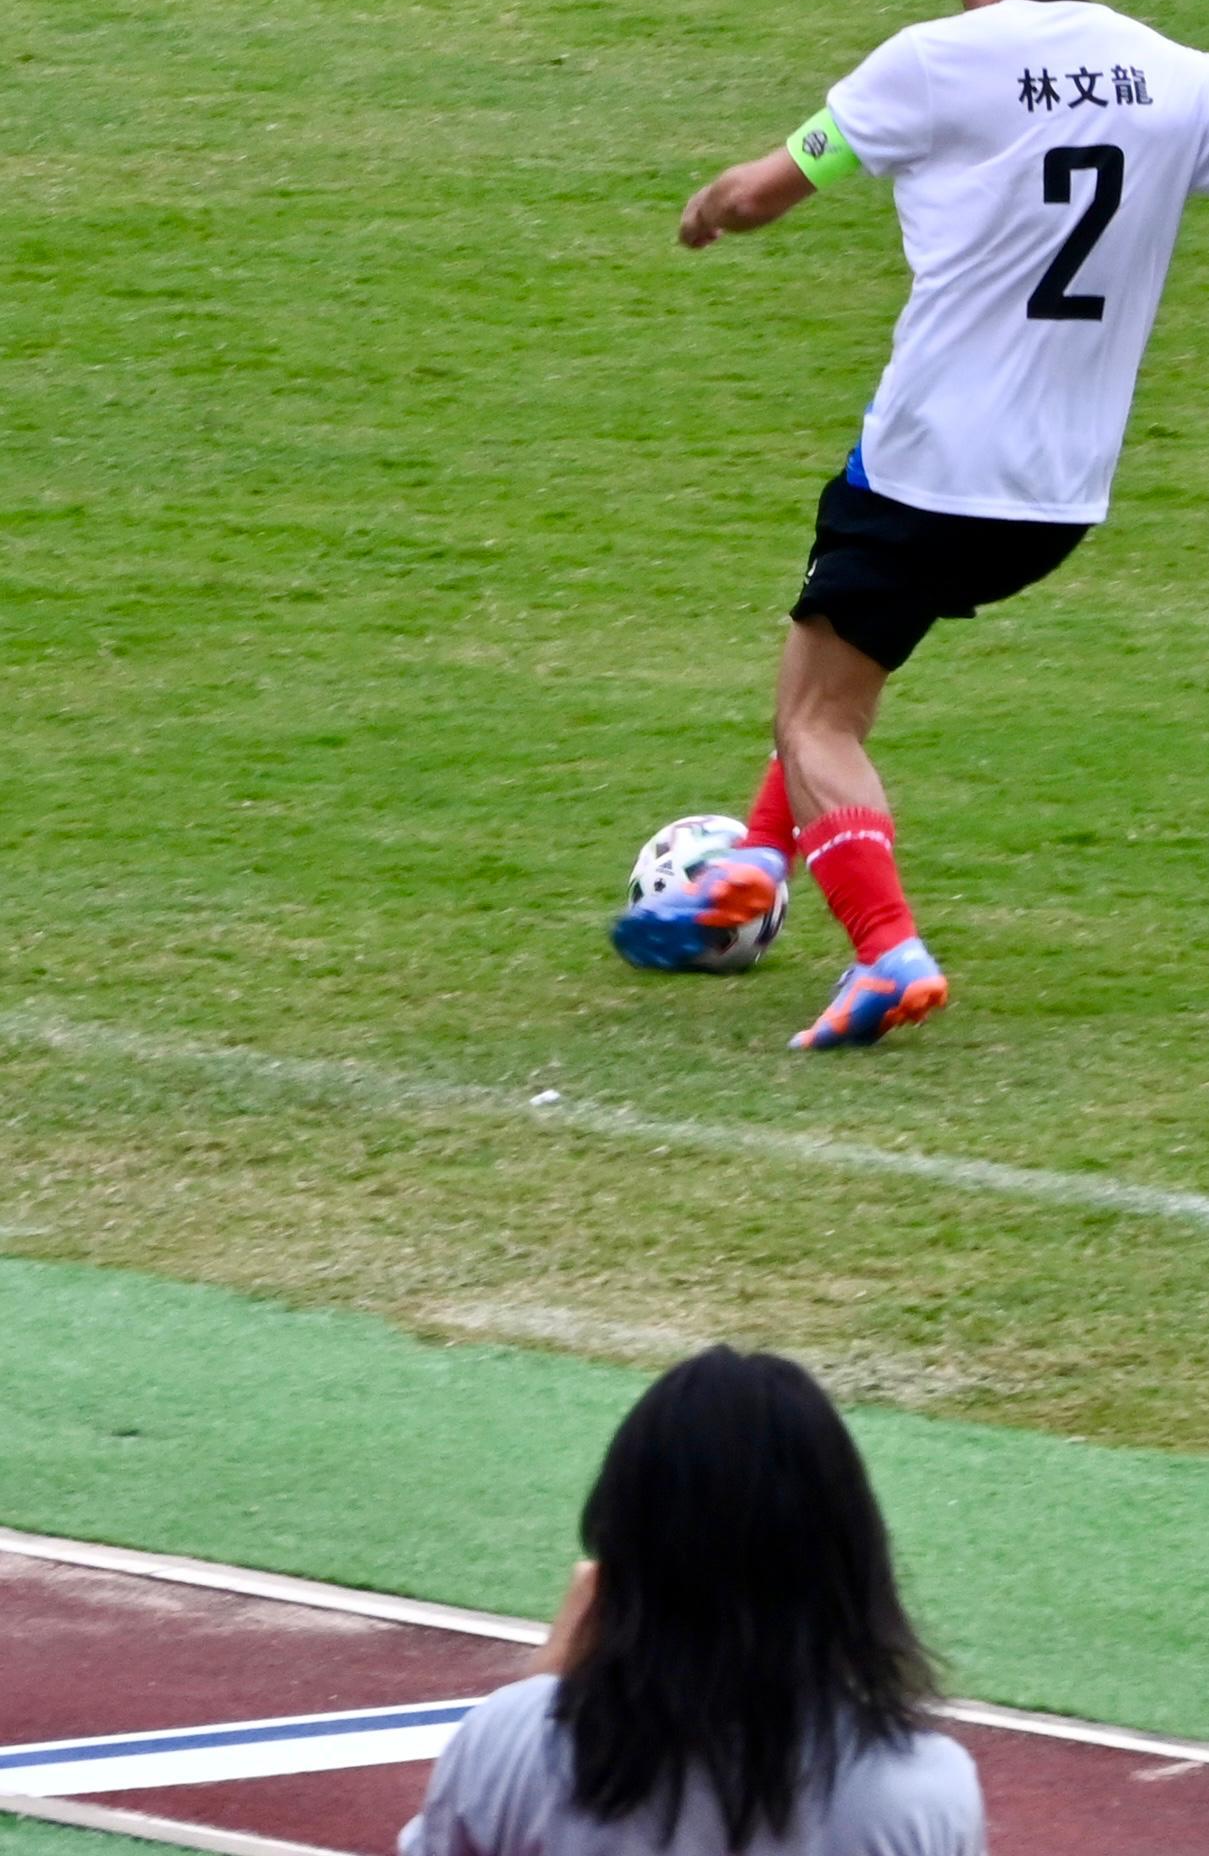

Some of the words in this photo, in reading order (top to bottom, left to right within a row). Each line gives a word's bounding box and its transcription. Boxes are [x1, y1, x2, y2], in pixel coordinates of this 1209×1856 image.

[1017, 65, 1154, 112] 林文龍
[1027, 144, 1124, 321] 2
